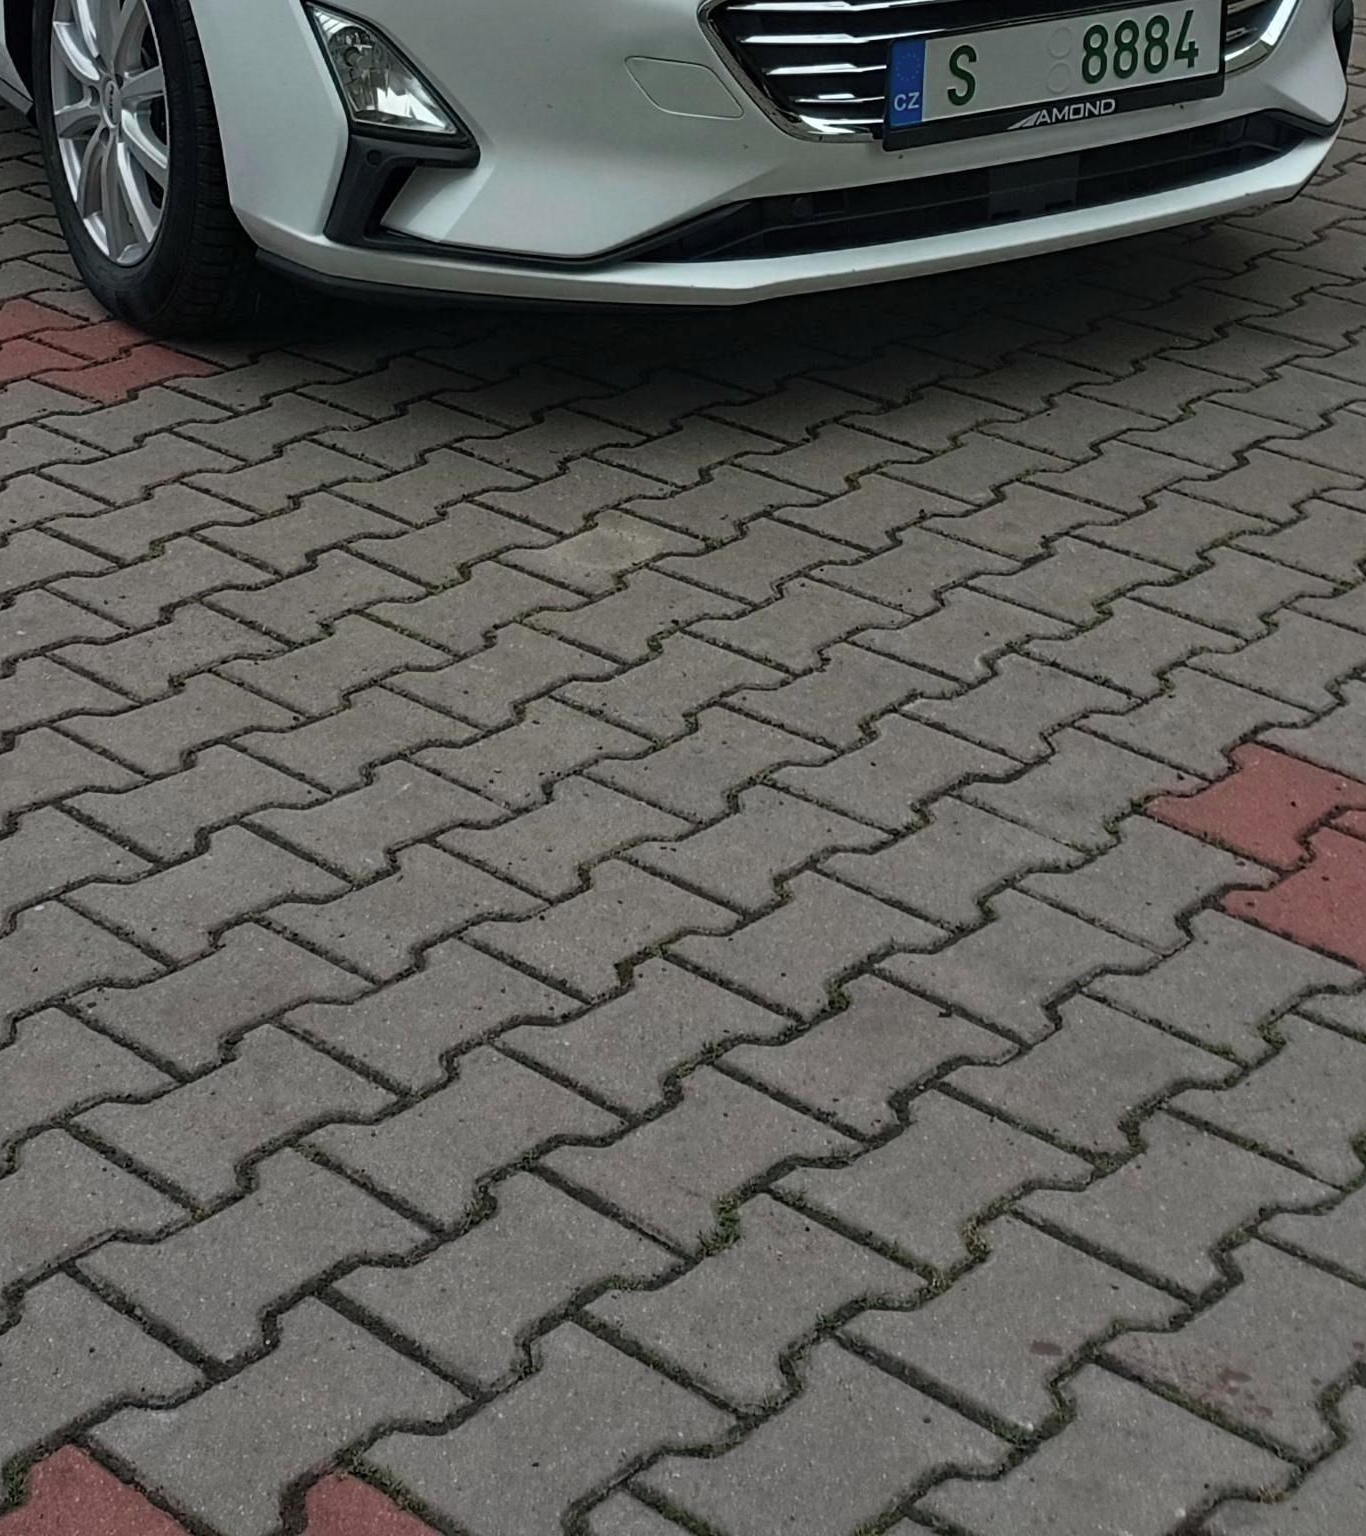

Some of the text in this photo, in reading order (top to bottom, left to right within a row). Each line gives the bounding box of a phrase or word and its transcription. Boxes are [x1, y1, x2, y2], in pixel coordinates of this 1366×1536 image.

[947, 9, 1199, 106] S 8884
[894, 91, 920, 111] CZ
[1036, 99, 1115, 125] AMOND
